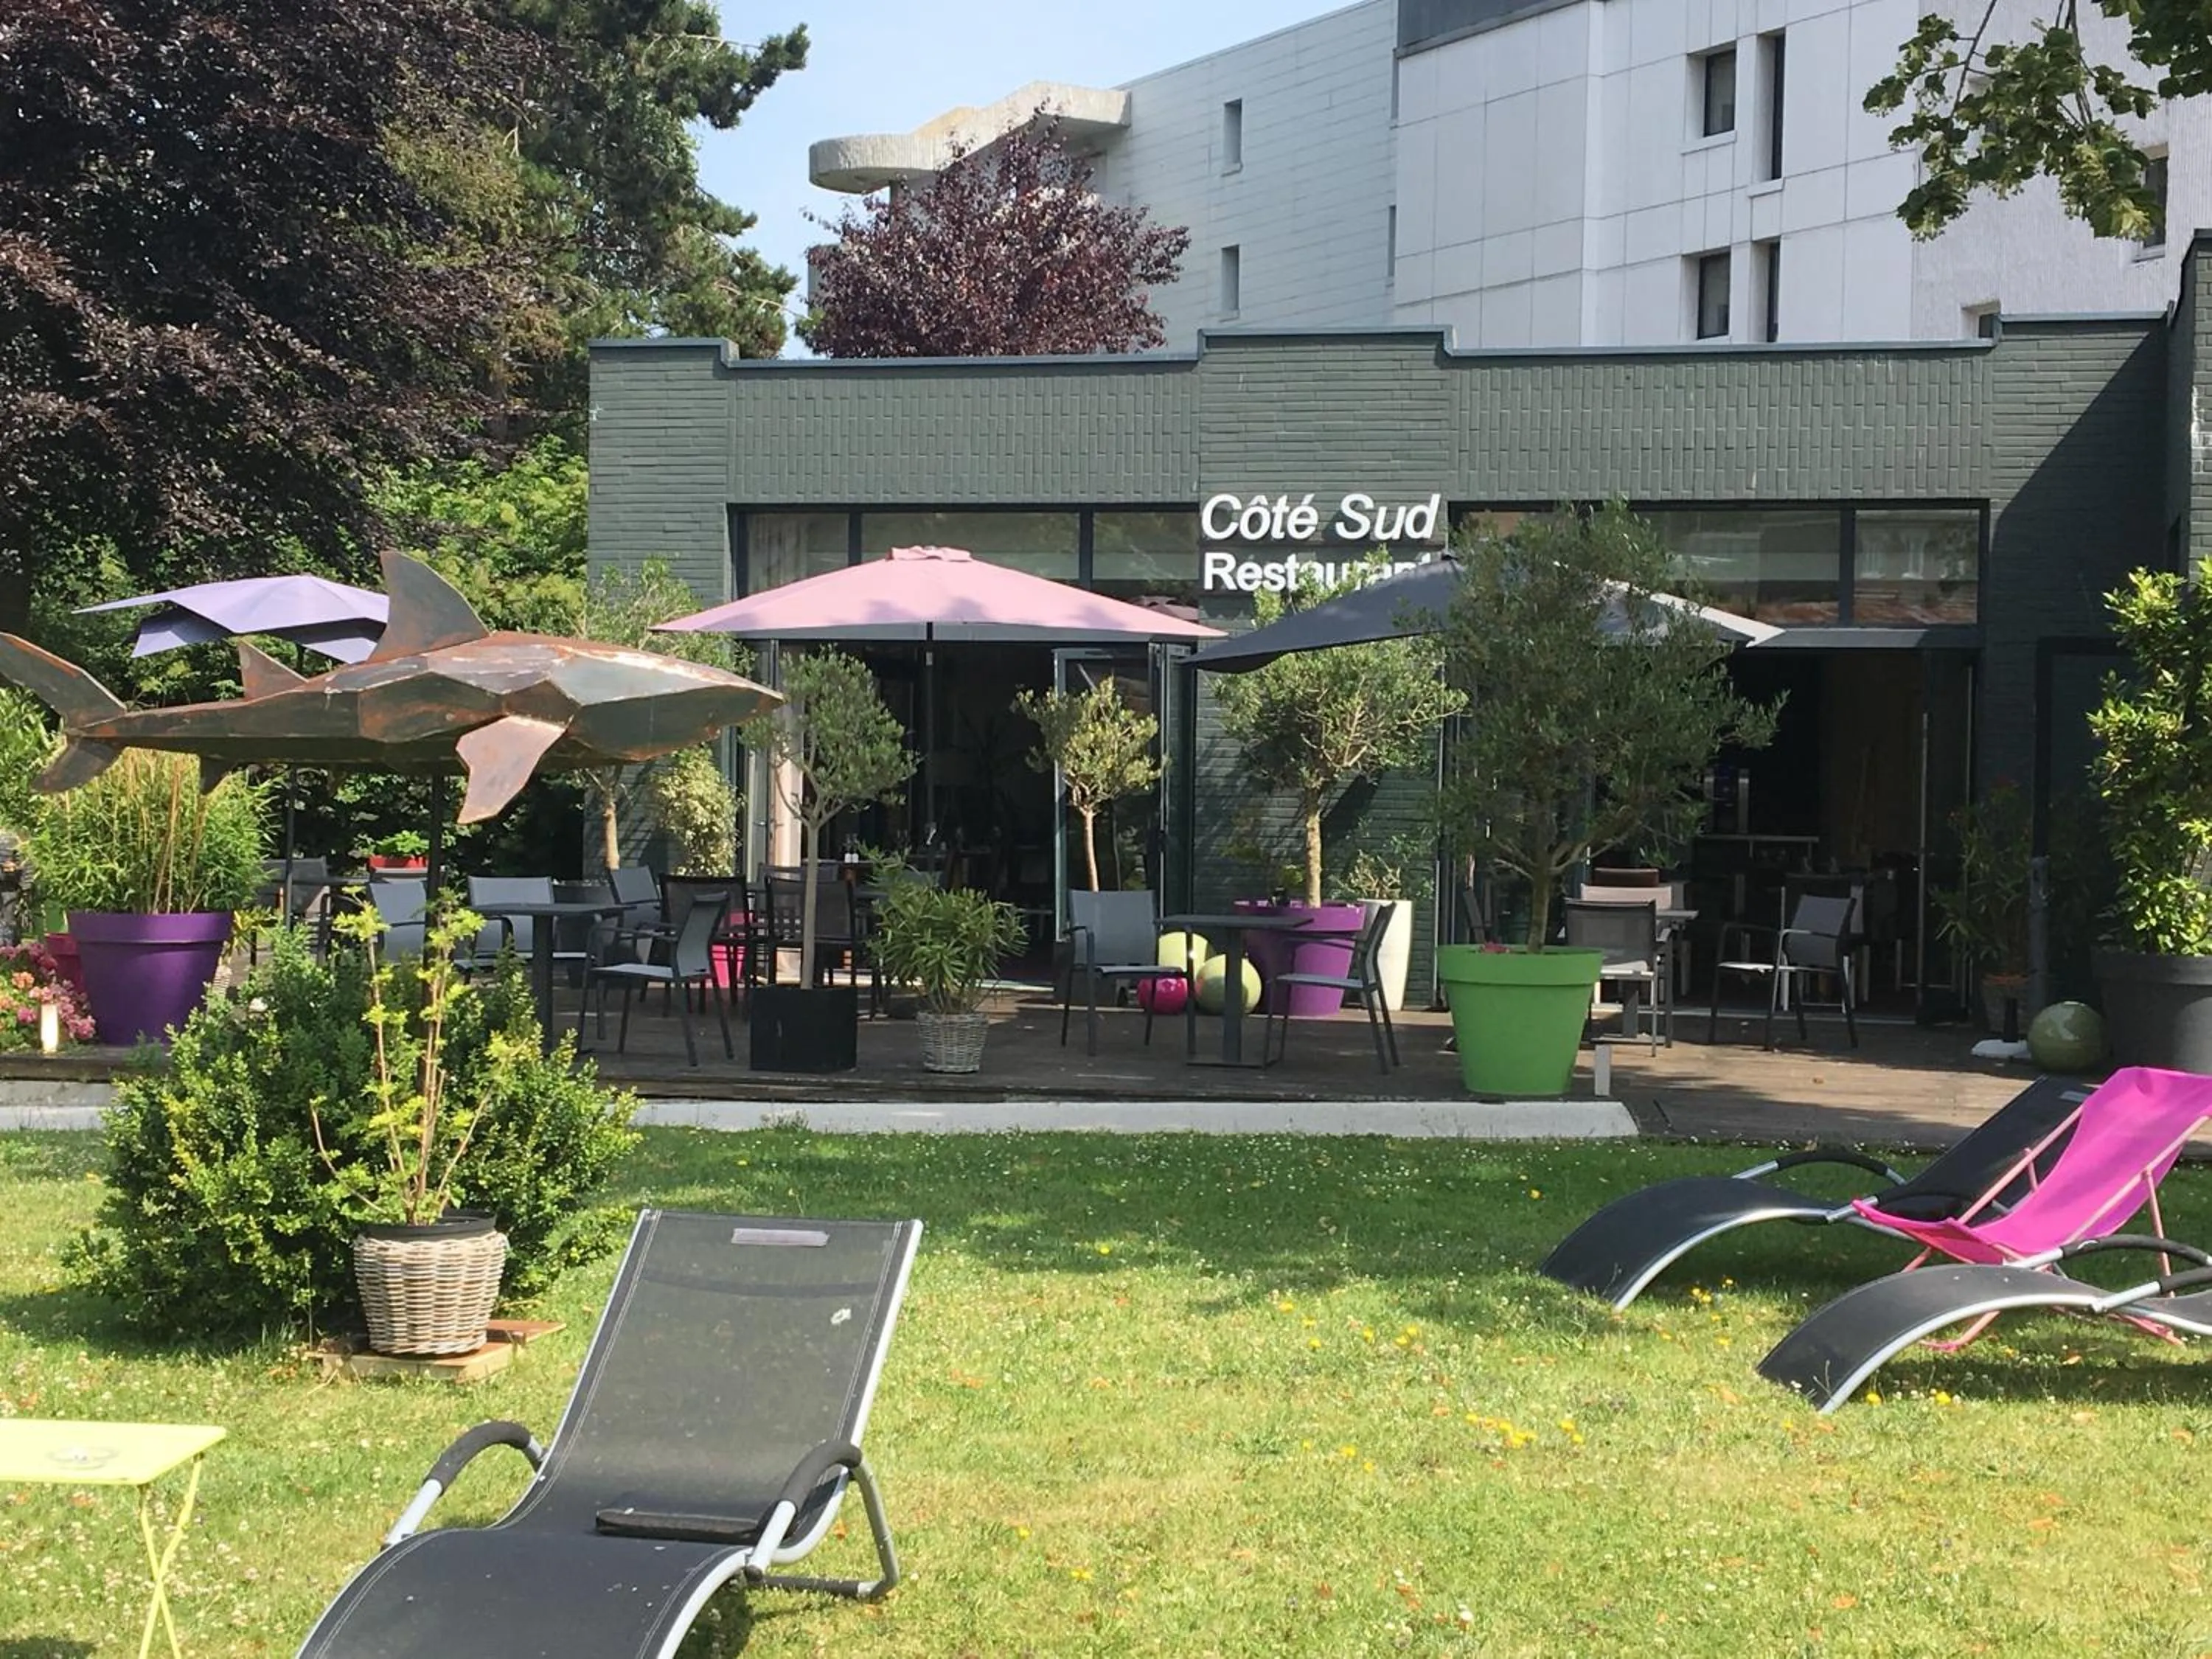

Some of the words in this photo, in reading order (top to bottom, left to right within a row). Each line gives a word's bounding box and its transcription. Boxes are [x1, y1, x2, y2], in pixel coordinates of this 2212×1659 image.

[1201, 493, 1318, 540] Côté
[1335, 493, 1441, 540] Sud
[1203, 552, 1432, 591] Restaura
